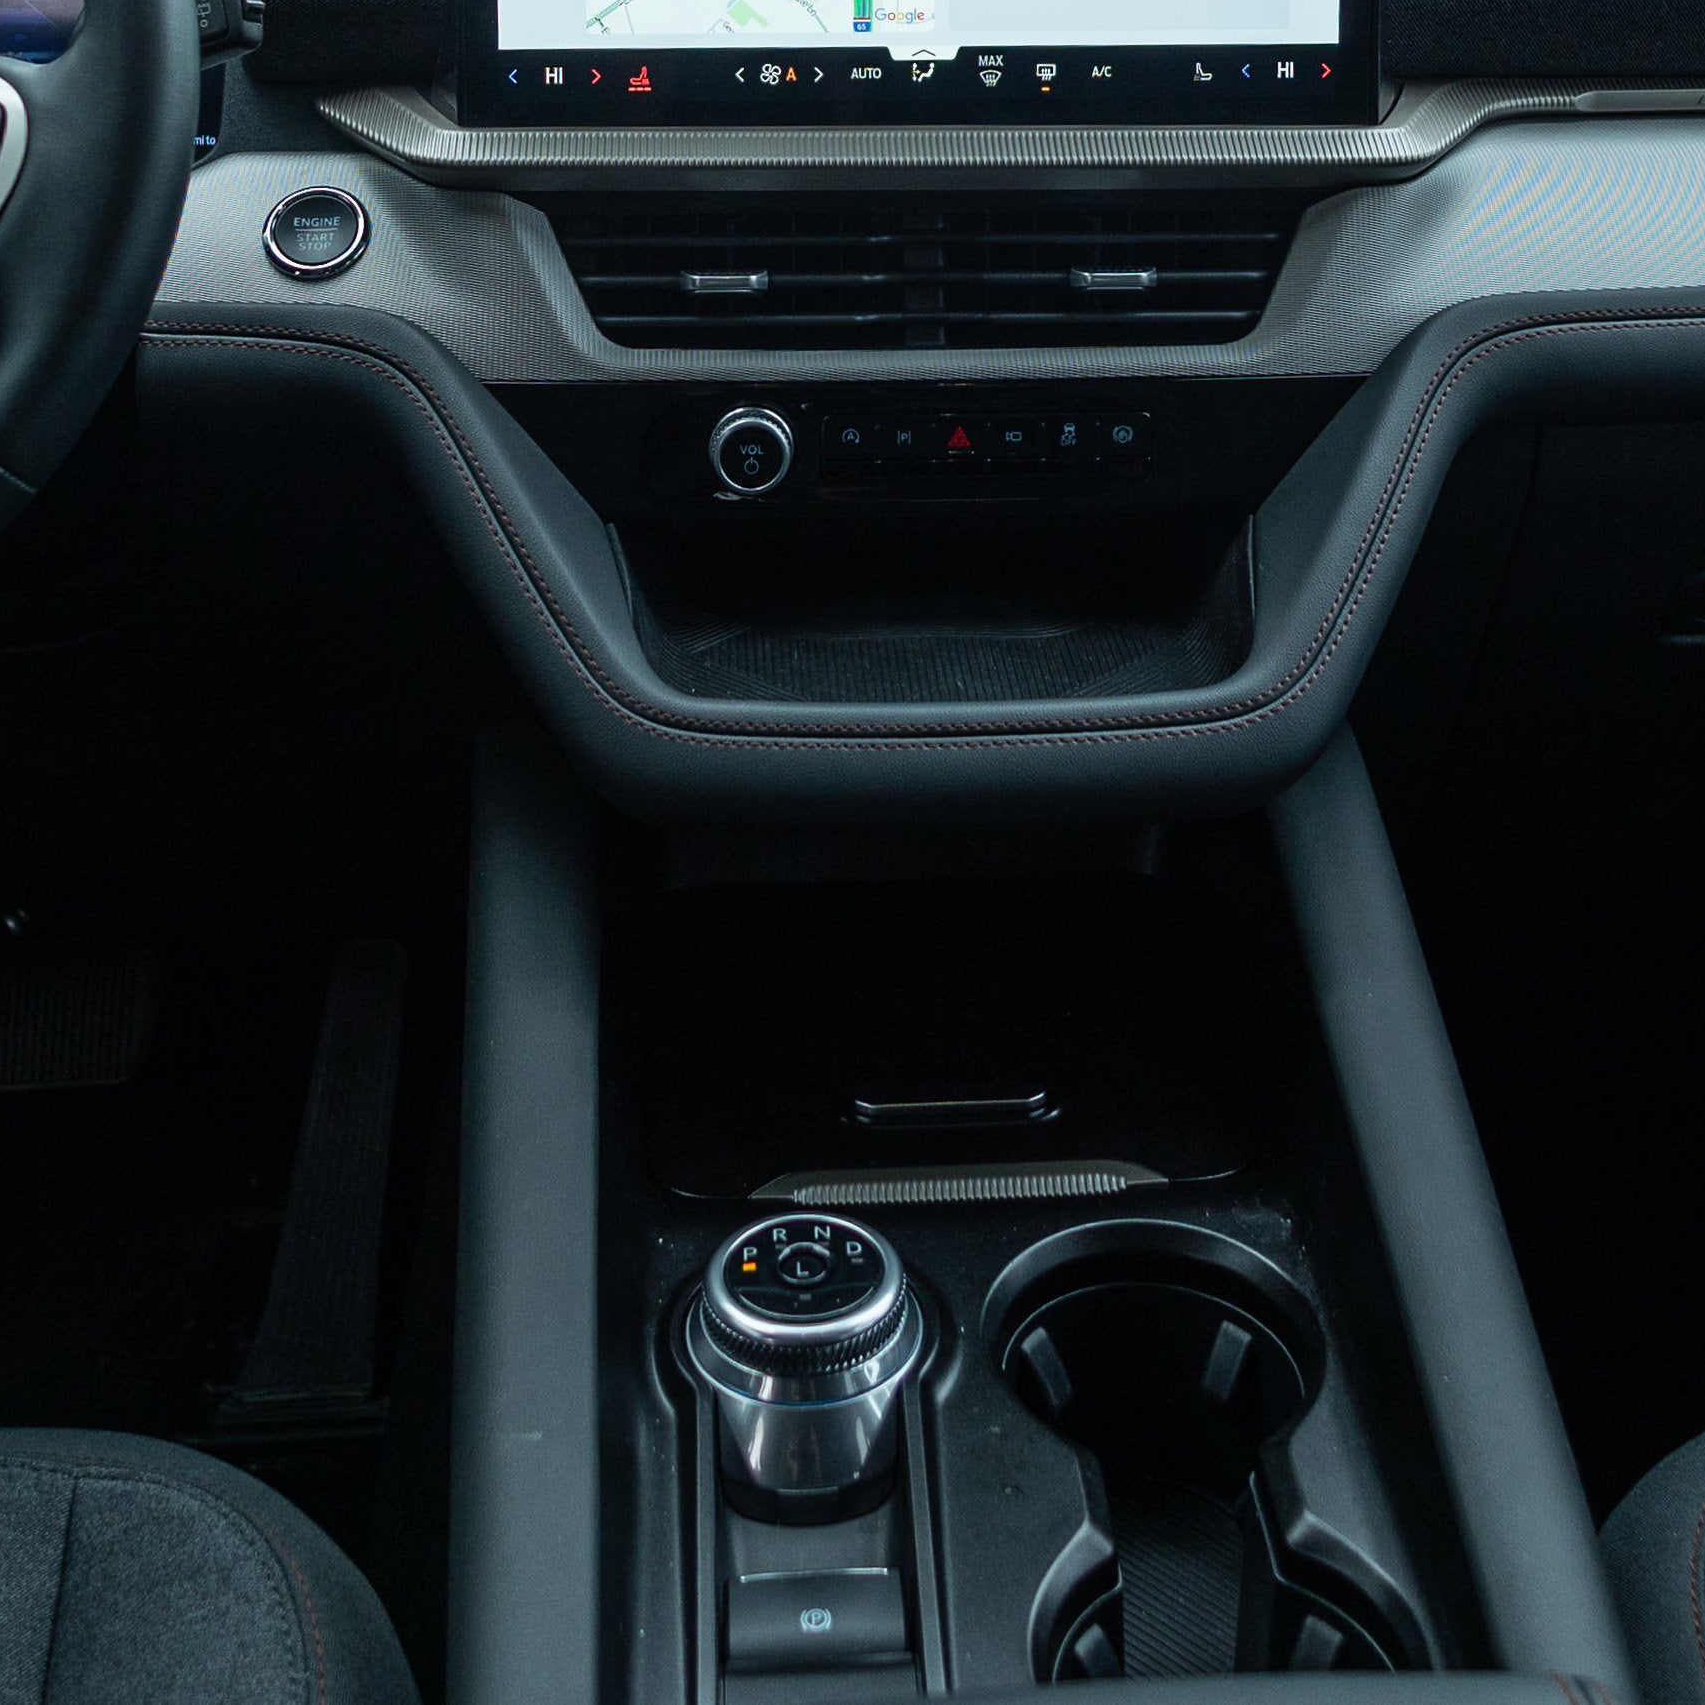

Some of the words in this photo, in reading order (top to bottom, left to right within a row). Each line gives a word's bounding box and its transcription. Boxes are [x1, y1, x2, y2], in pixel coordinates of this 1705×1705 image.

[874, 7, 926, 25] Google
[977, 54, 1004, 67] MAX
[544, 66, 565, 85] HI
[785, 67, 797, 82] A
[850, 67, 882, 80] AUTO
[1091, 64, 1113, 79] A/C
[1276, 62, 1295, 79] HI
[206, 135, 216, 145] to
[293, 216, 341, 227] ENGINE
[296, 232, 334, 242] START
[298, 242, 332, 251] STOP
[739, 444, 764, 456] VOL
[773, 1227, 786, 1242] R
[813, 1226, 830, 1241] N
[742, 1246, 757, 1262] P
[846, 1240, 862, 1257] D
[796, 1262, 809, 1278] L
